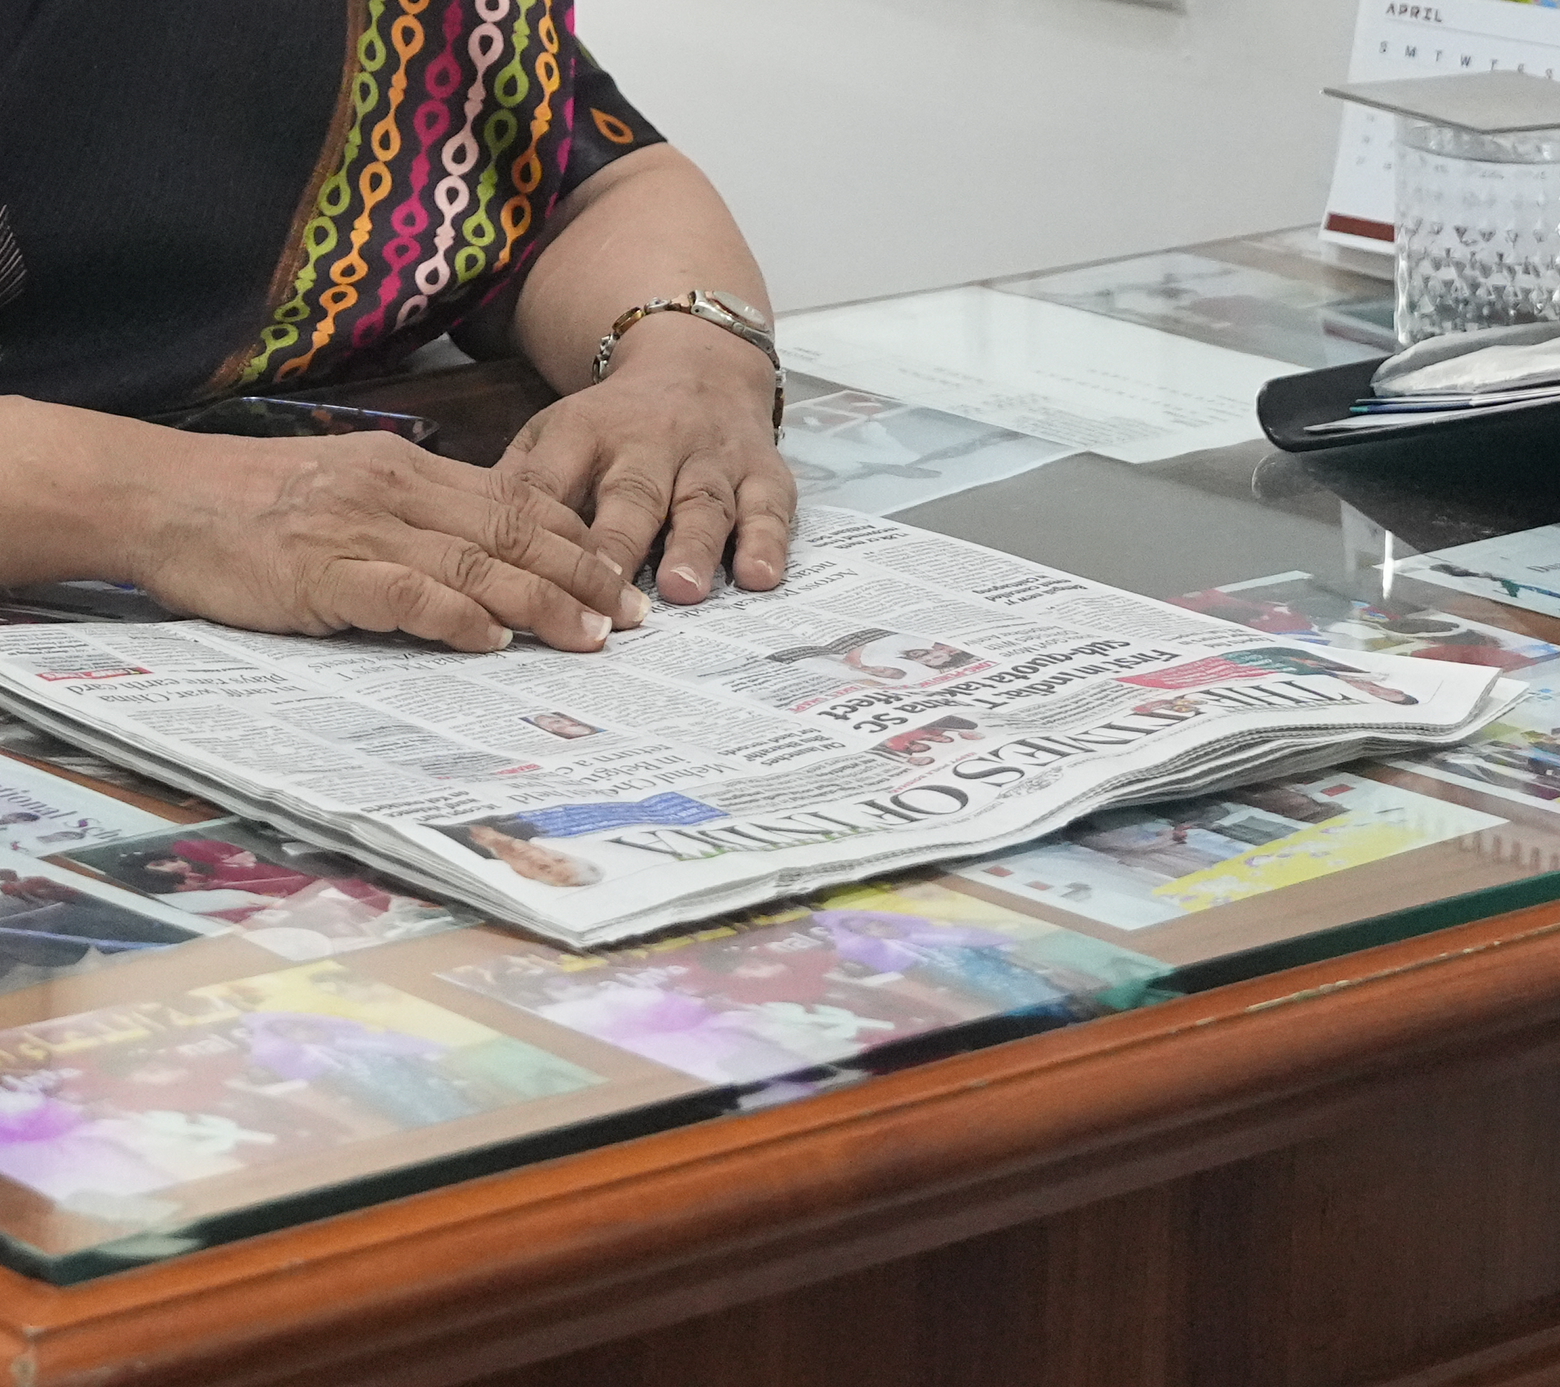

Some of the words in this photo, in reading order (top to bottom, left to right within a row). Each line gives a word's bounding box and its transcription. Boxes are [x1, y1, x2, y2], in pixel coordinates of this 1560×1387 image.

[1386, 1, 1443, 23] APRIL
[1379, 41, 1387, 54] S
[1405, 46, 1417, 58] M
[1434, 50, 1443, 61] T
[1460, 55, 1471, 67] W
[792, 568, 862, 591] Across
[979, 639, 1135, 685] sub-quota
[1069, 664, 1123, 677] in
[1100, 648, 1182, 671] First
[64, 683, 115, 695] card
[116, 678, 183, 690] earth
[229, 673, 291, 684] plays
[278, 685, 307, 693] In
[989, 671, 1087, 699] India:
[96, 691, 171, 703] China
[164, 688, 208, 697] war,
[219, 688, 272, 698] tariff
[1183, 680, 1352, 709] THE
[853, 713, 908, 734] SC
[953, 712, 1205, 785] TIMES
[650, 761, 738, 783] Mehul
[855, 786, 971, 824] OF
[607, 811, 874, 859] INDIA
